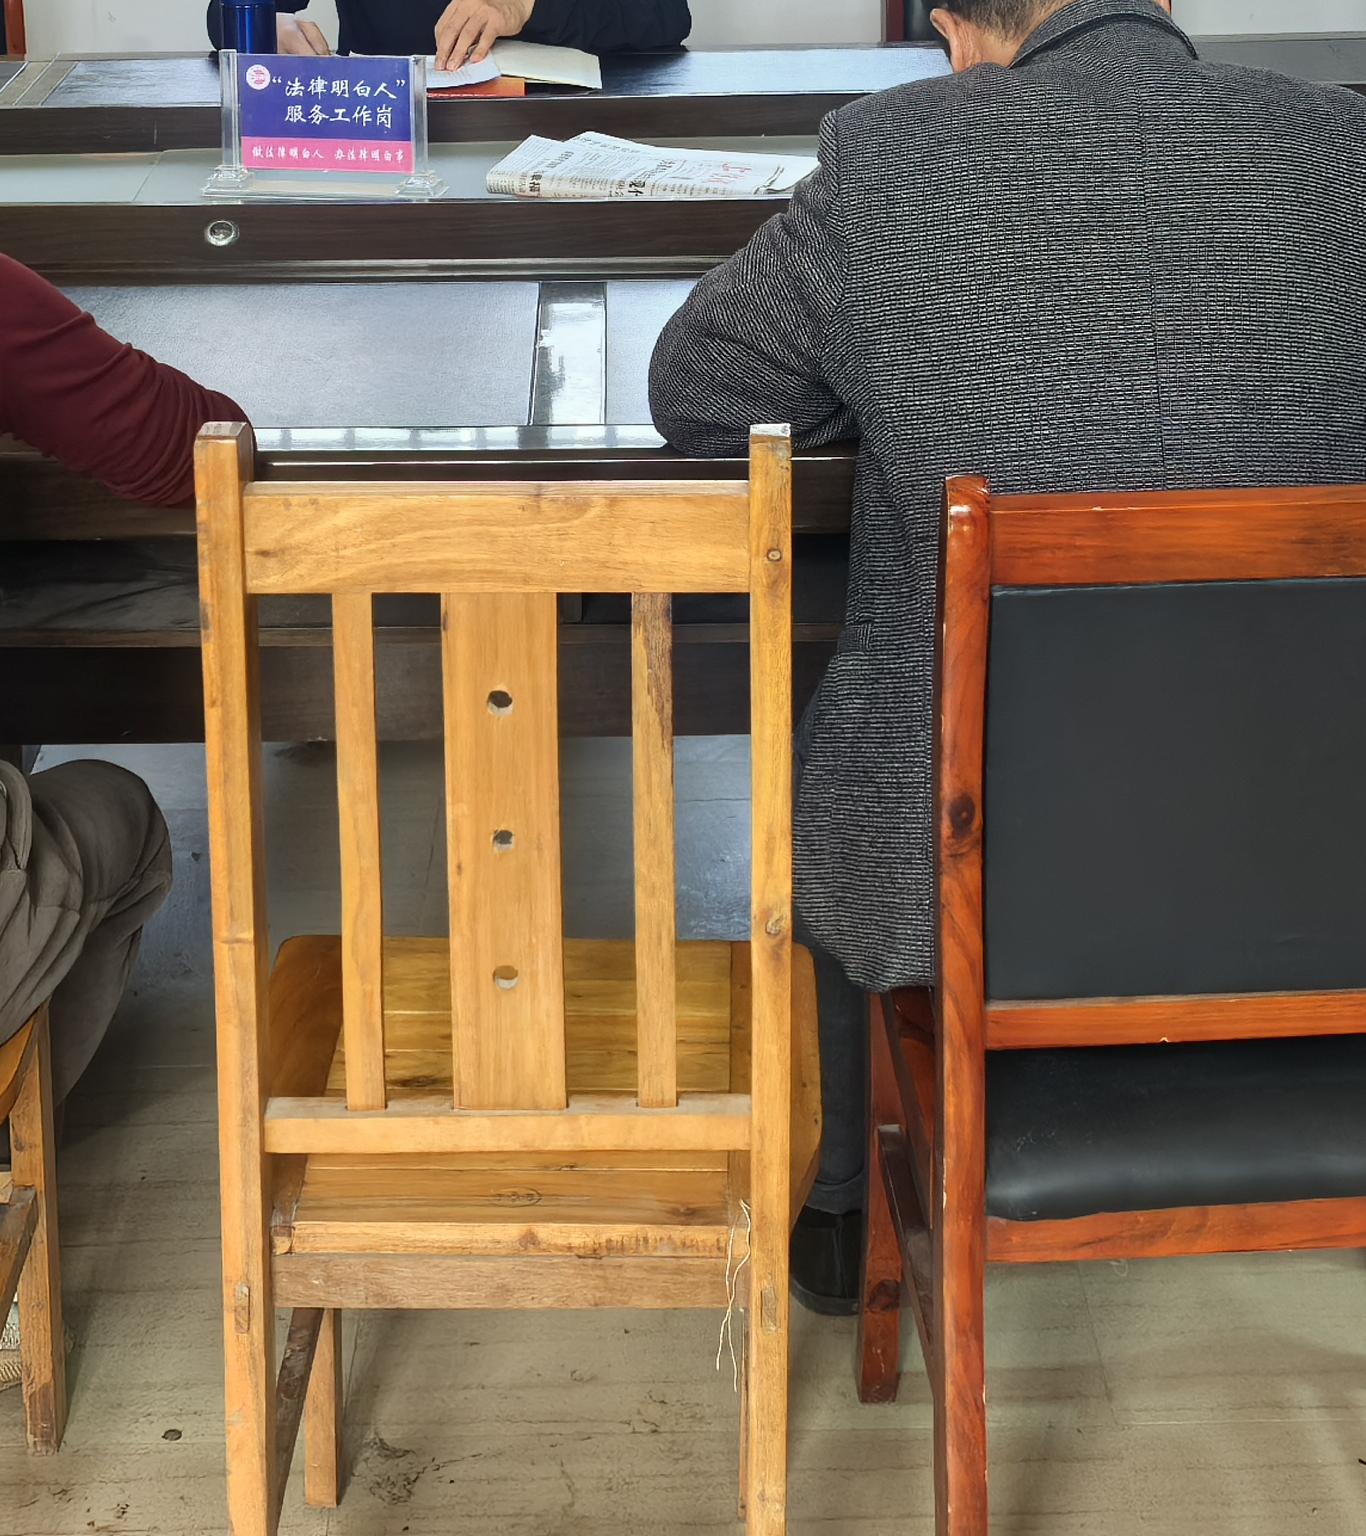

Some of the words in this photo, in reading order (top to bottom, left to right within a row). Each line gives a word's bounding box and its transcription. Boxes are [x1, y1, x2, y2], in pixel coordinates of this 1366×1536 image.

[271, 75, 407, 100] “法律明白人”
[284, 104, 394, 129] 服务工作岗
